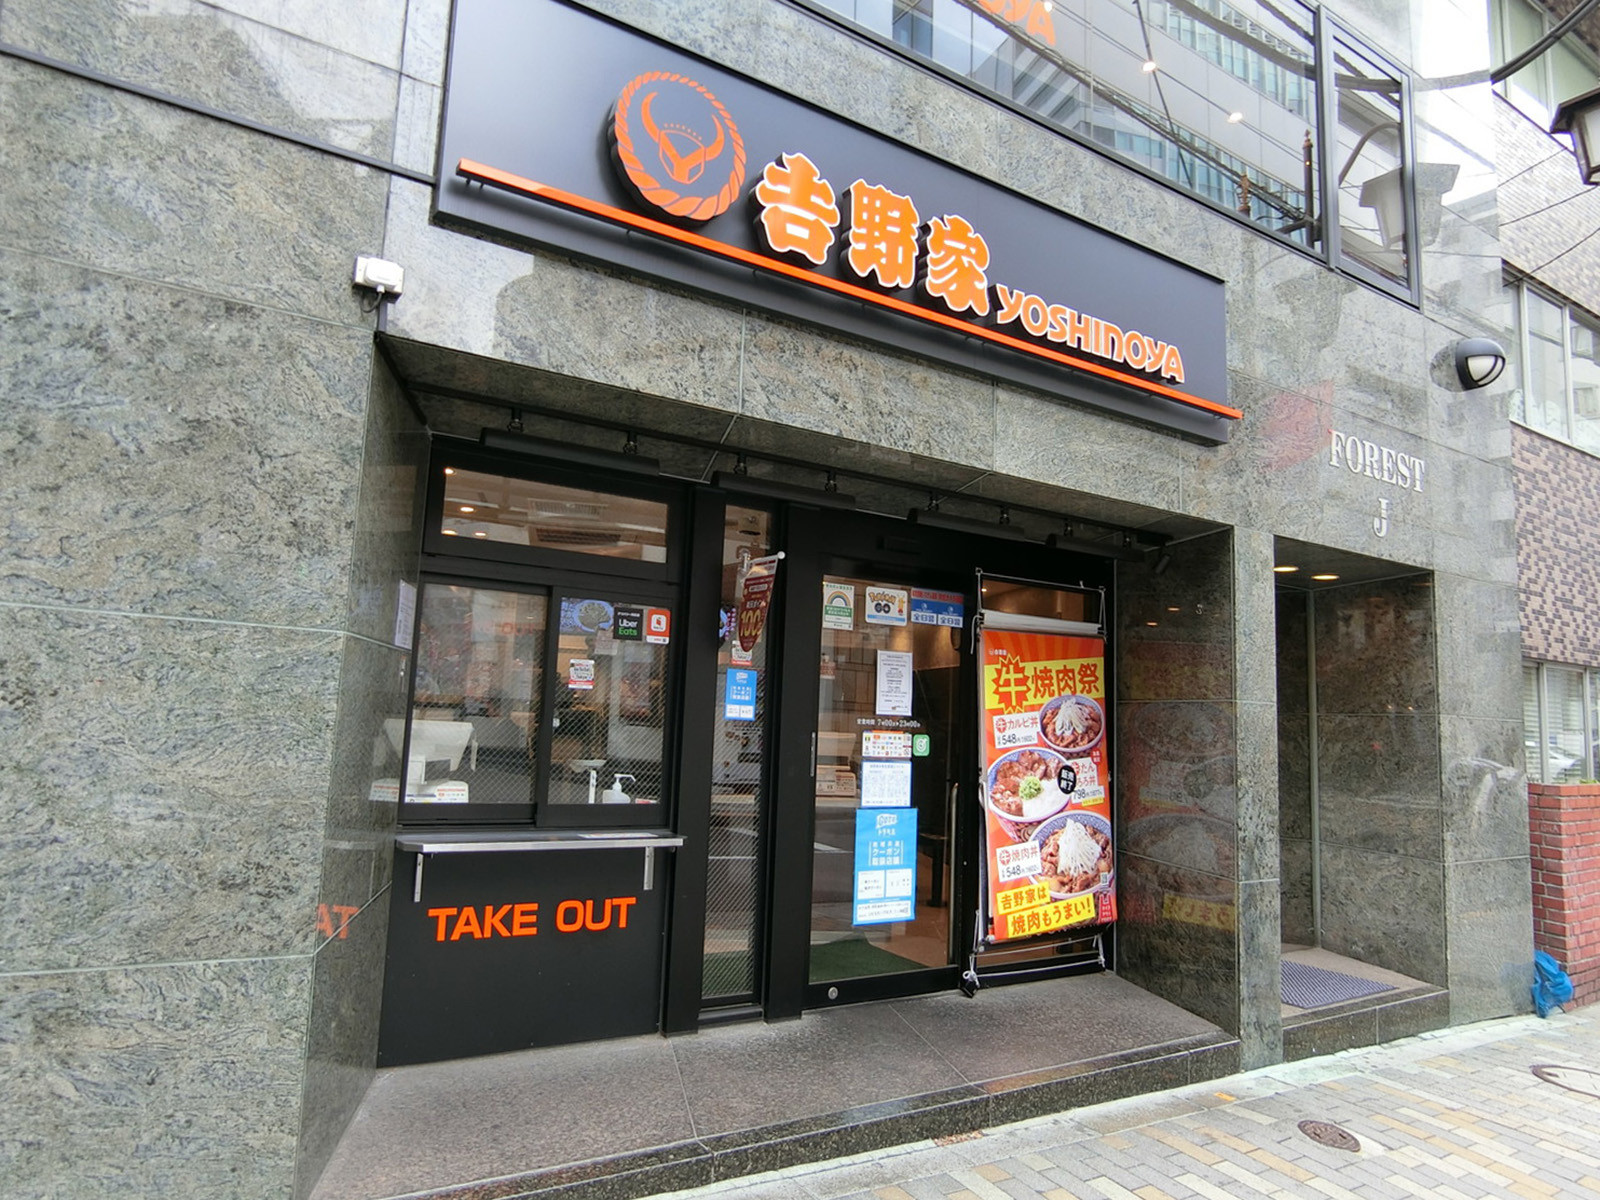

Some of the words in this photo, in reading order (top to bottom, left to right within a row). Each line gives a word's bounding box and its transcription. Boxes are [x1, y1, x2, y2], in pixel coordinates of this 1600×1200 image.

[756, 152, 990, 316] 吉野家
[995, 283, 1185, 384] YOSHINOYA
[1329, 430, 1425, 493] FOREST
[1373, 498, 1389, 538] J
[618, 618, 638, 628] Uber
[618, 627, 638, 636] Eats
[999, 663, 1099, 706] 牛焼肉祭
[428, 902, 538, 942] TAKE
[555, 896, 637, 933] OUT
